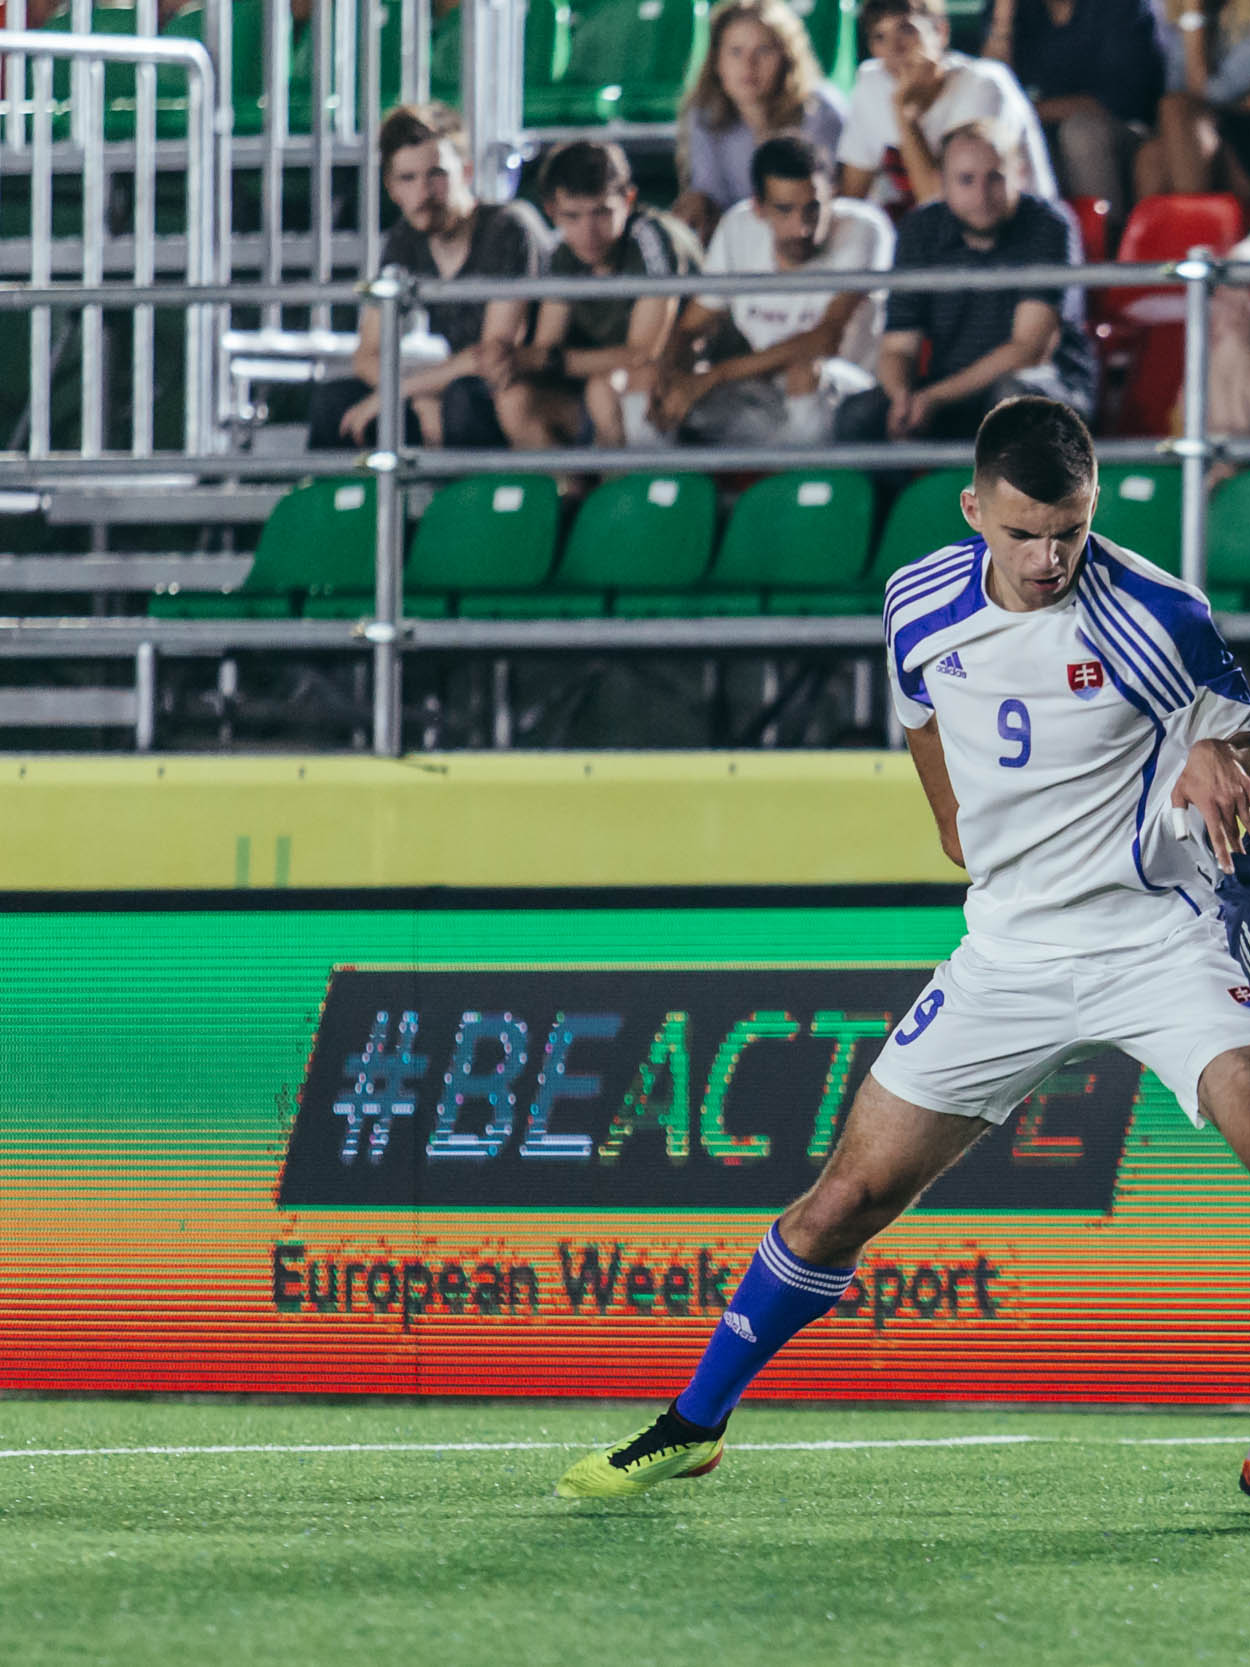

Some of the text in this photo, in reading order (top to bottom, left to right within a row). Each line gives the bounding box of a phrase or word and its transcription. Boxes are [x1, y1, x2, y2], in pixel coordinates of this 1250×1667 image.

[997, 698, 1031, 768] 9
[895, 989, 944, 1046] 9
[334, 1010, 1097, 1165] #BEACTE
[273, 1243, 539, 1334] European
[559, 1243, 730, 1316] Week
